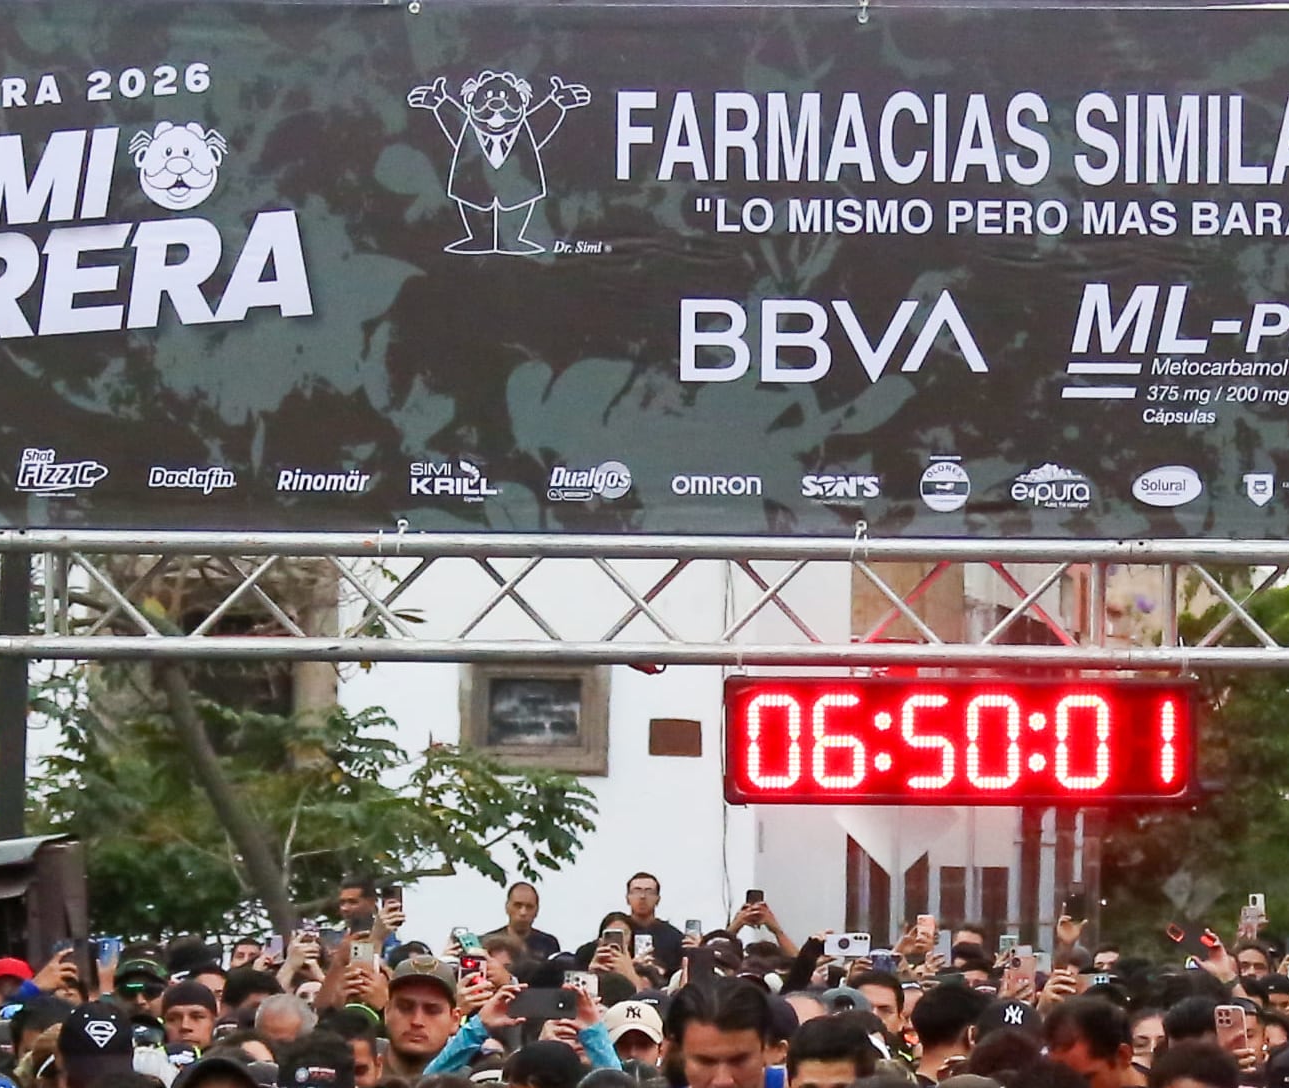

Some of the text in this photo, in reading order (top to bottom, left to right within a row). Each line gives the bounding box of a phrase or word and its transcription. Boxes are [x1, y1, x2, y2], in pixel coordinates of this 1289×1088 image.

[86, 62, 212, 104] 2026
[616, 90, 1052, 184] FARMACIAS
[694, 197, 774, 235] "LO
[808, 198, 935, 236] MISMO
[948, 199, 1067, 236] PERO
[1081, 200, 1178, 237] MAS
[553, 241, 602, 254] Dr. Simi
[679, 289, 989, 384] BBVA
[1151, 358, 1288, 377] Metocarbamol
[1147, 386, 1289, 406] 375 mg / 200 mg
[1143, 408, 1216, 425] Cápsulas
[410, 462, 452, 476] SIMI
[550, 466, 631, 492] Dualgos
[148, 467, 234, 495] Daclafin
[277, 468, 371, 492] Rinomär
[410, 478, 498, 496] KRILL
[671, 475, 762, 496] OMRON
[1141, 479, 1187, 492] Solural
